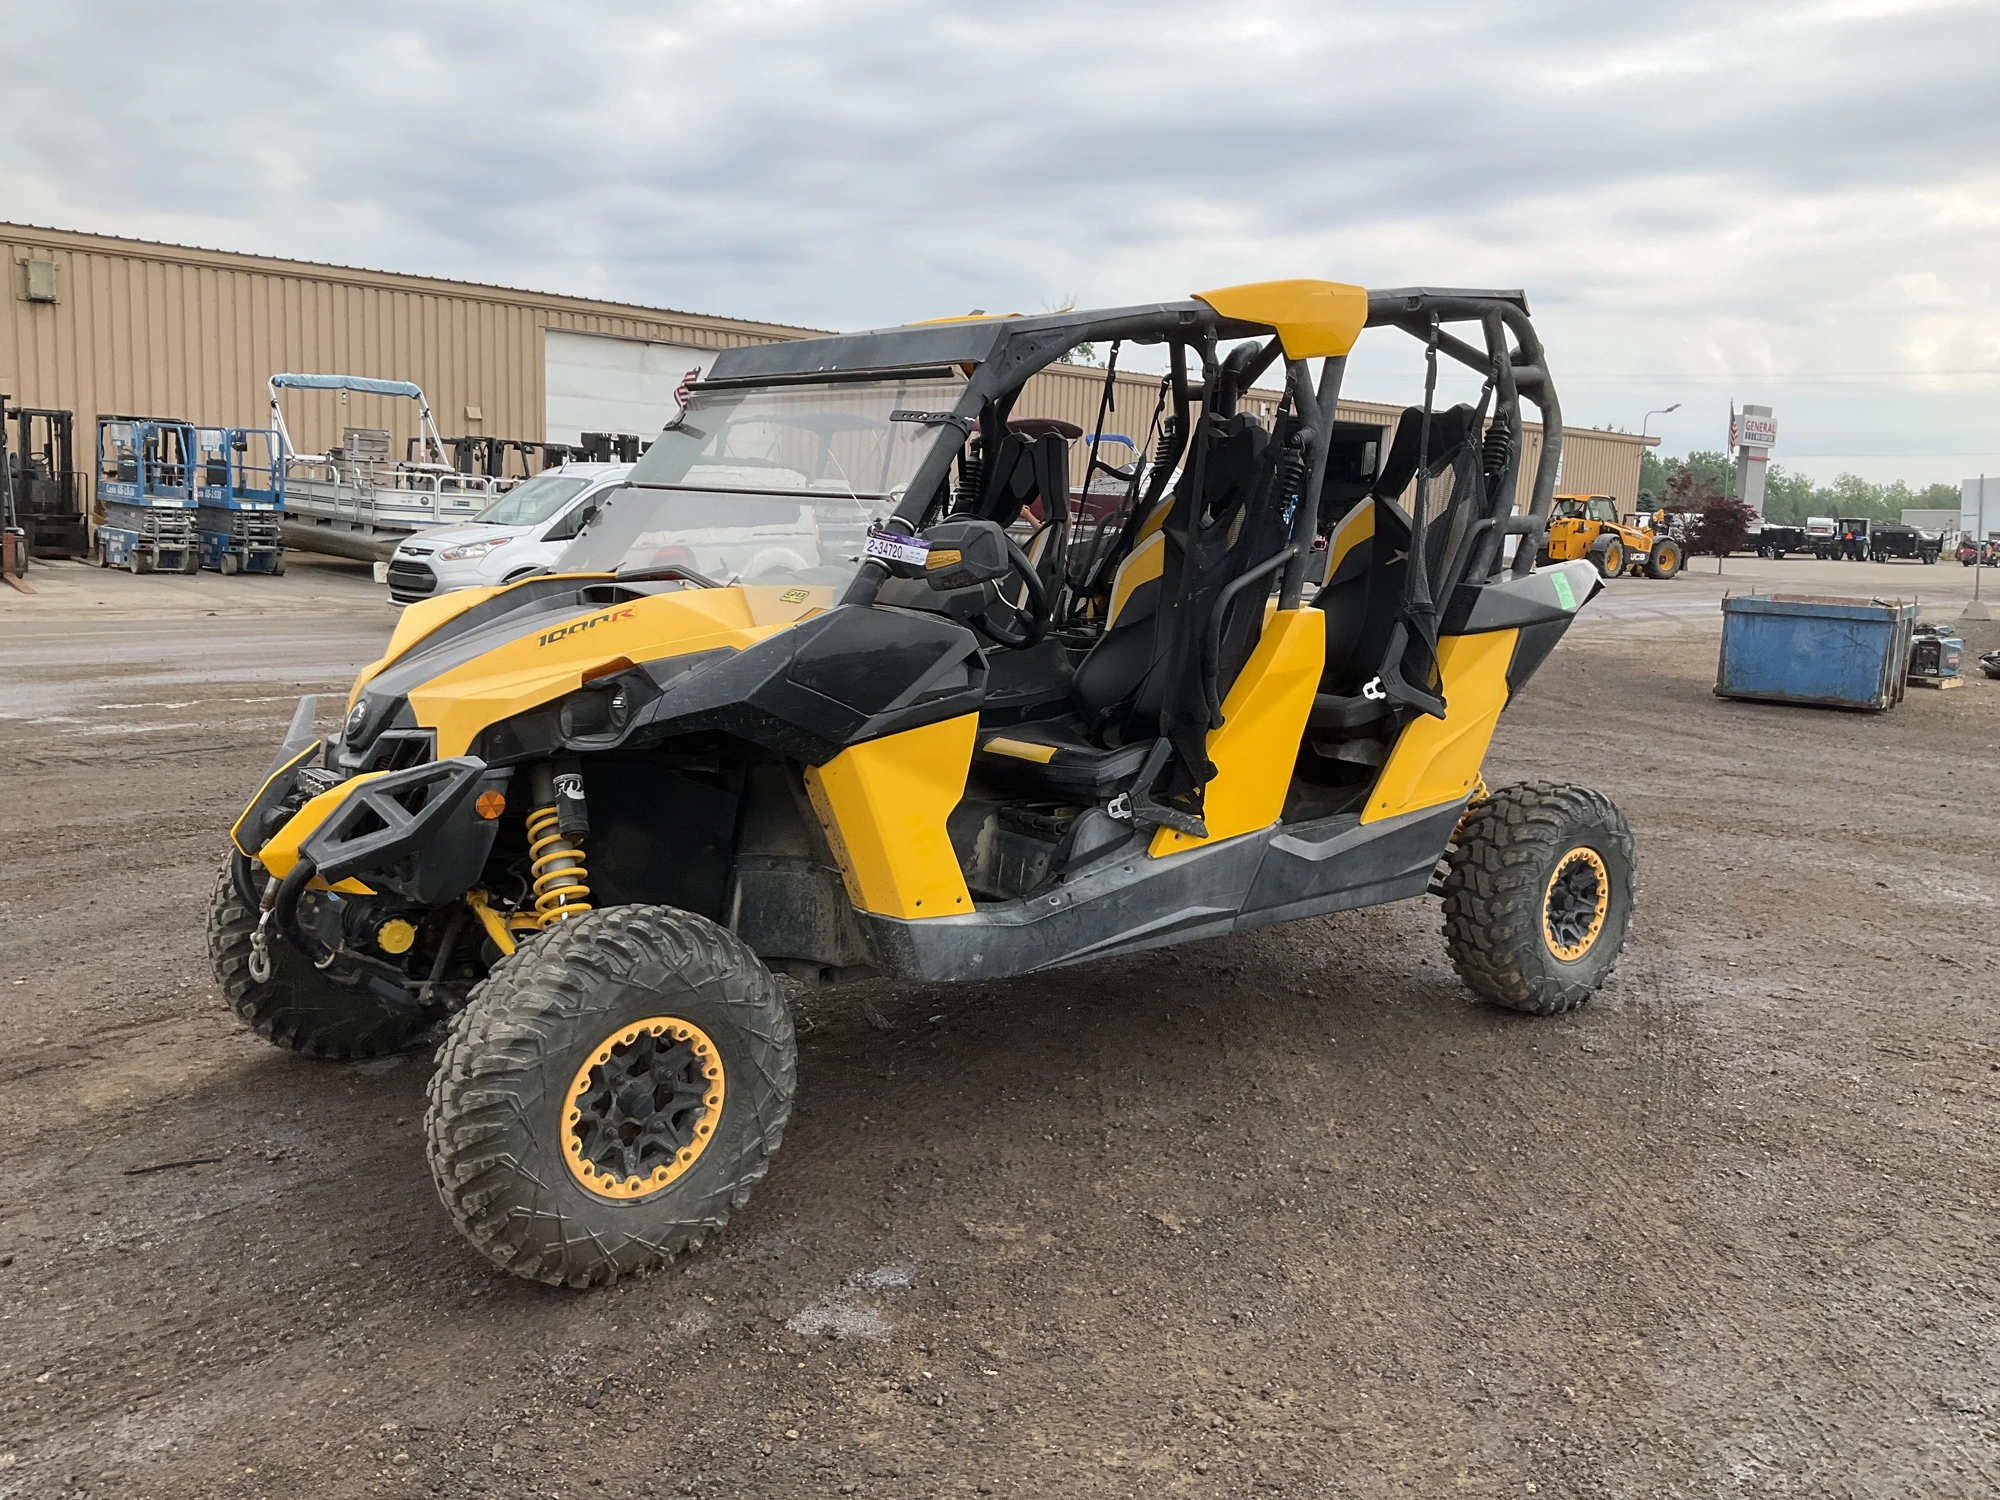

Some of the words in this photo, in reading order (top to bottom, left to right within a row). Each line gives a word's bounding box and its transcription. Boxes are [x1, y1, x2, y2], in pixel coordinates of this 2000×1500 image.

[1745, 420, 1776, 434] GENERAL
[867, 539, 903, 559] 2-34720
[1630, 552, 1646, 561] JCB
[539, 608, 635, 648] 1000R
